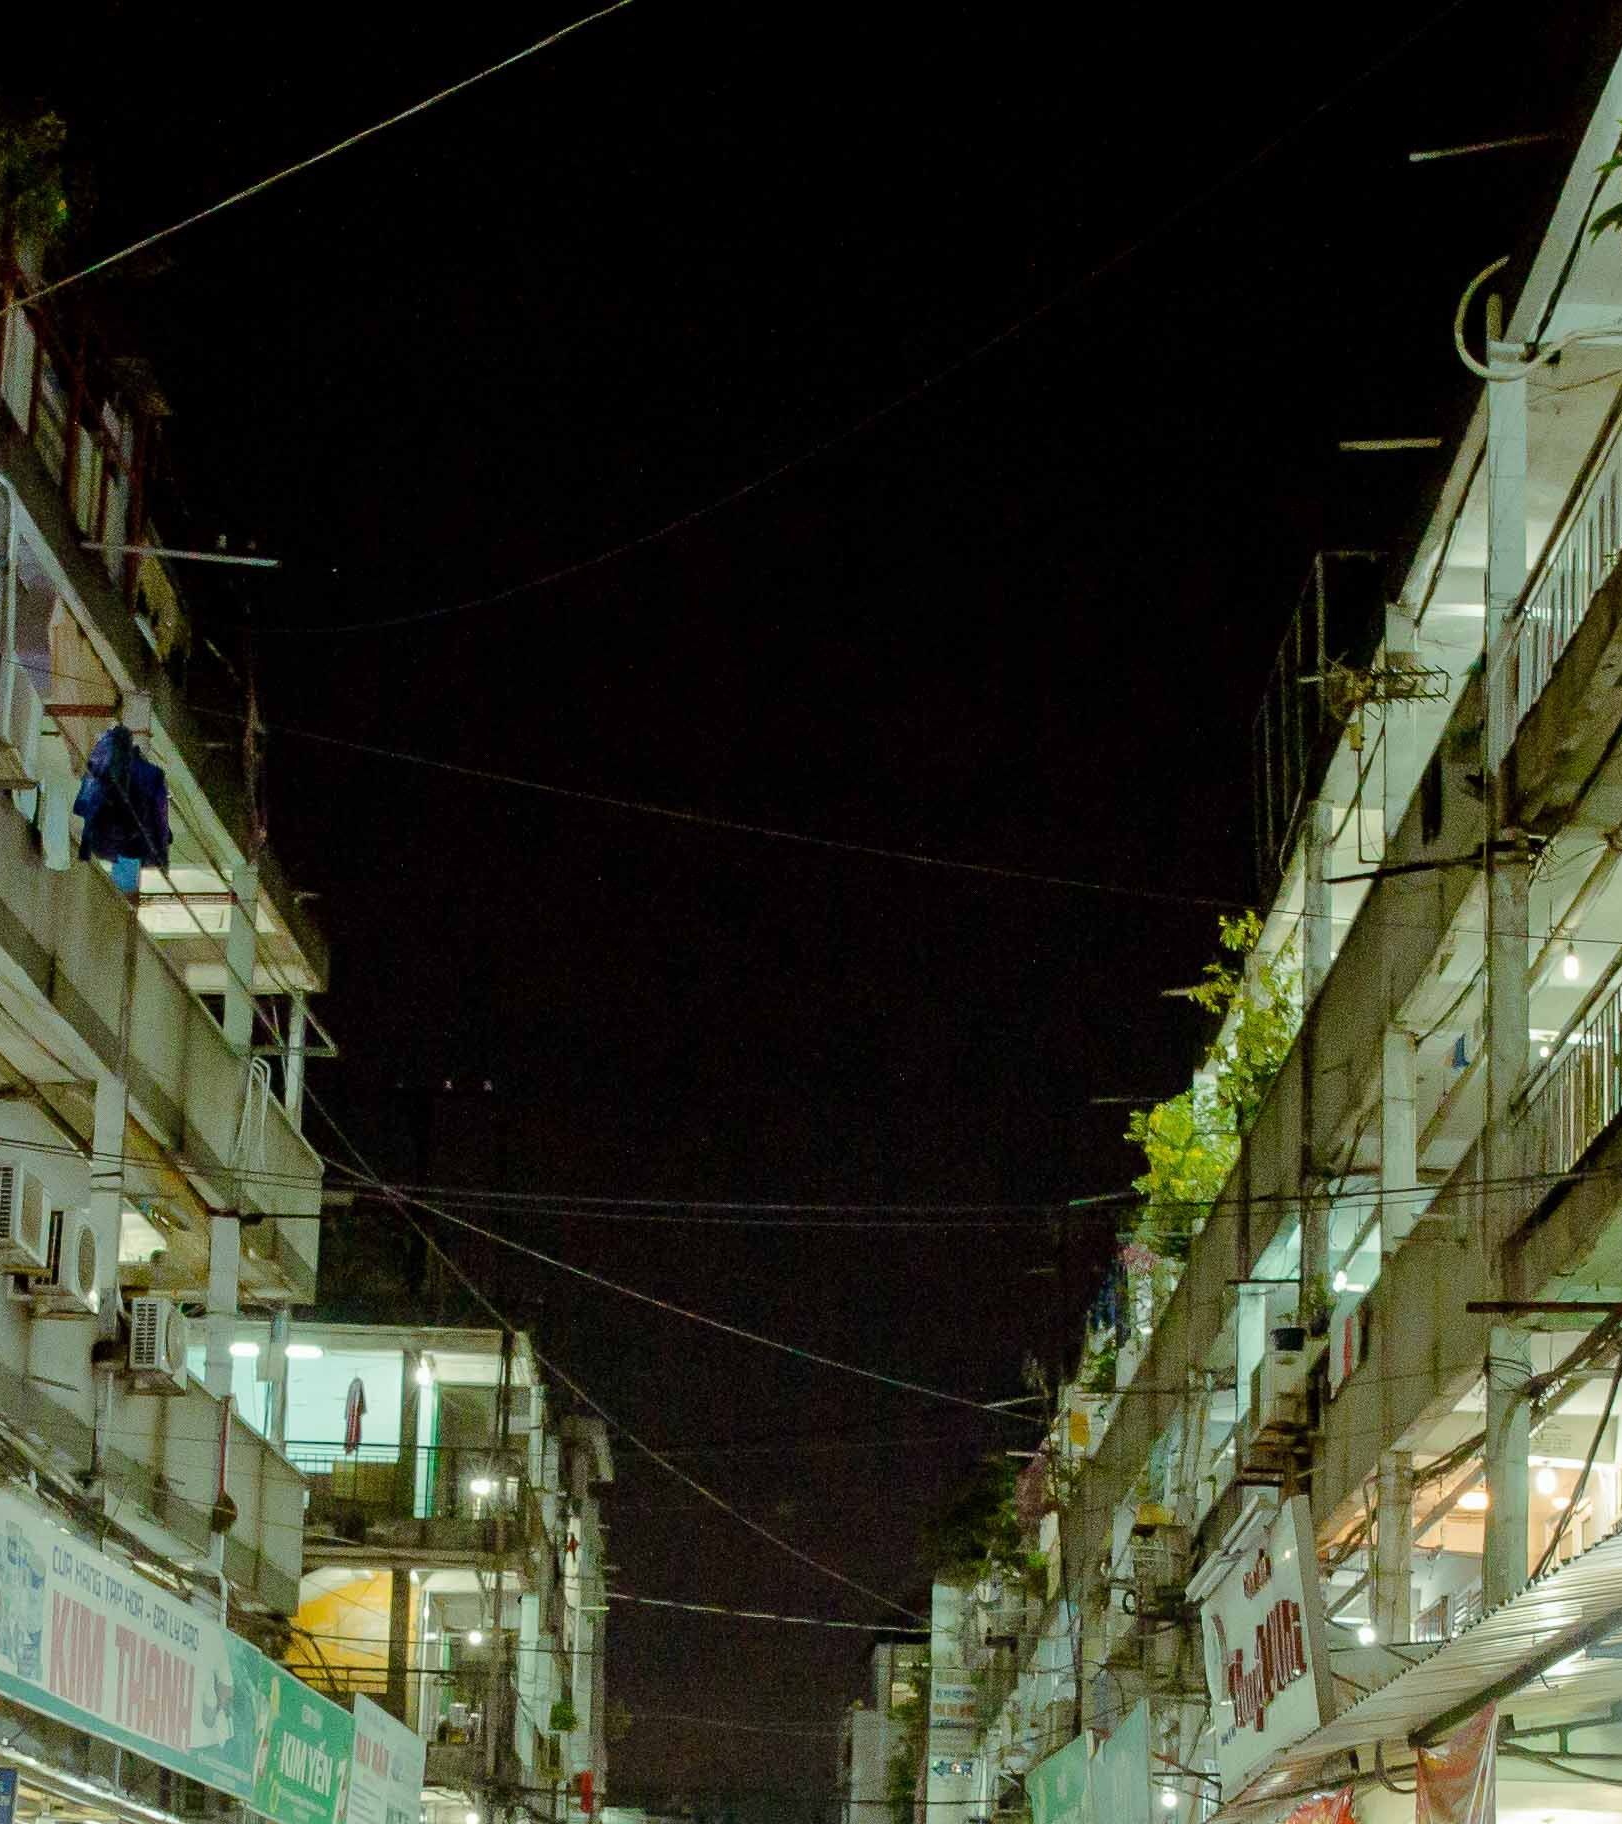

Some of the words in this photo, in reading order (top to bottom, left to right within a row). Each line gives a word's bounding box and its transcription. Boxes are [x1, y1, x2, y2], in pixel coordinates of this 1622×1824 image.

[49, 1589, 107, 1715] KIM
[115, 1623, 195, 1755] THANH
[280, 1731, 308, 1783] KIM
[308, 1739, 333, 1797] YẾN
